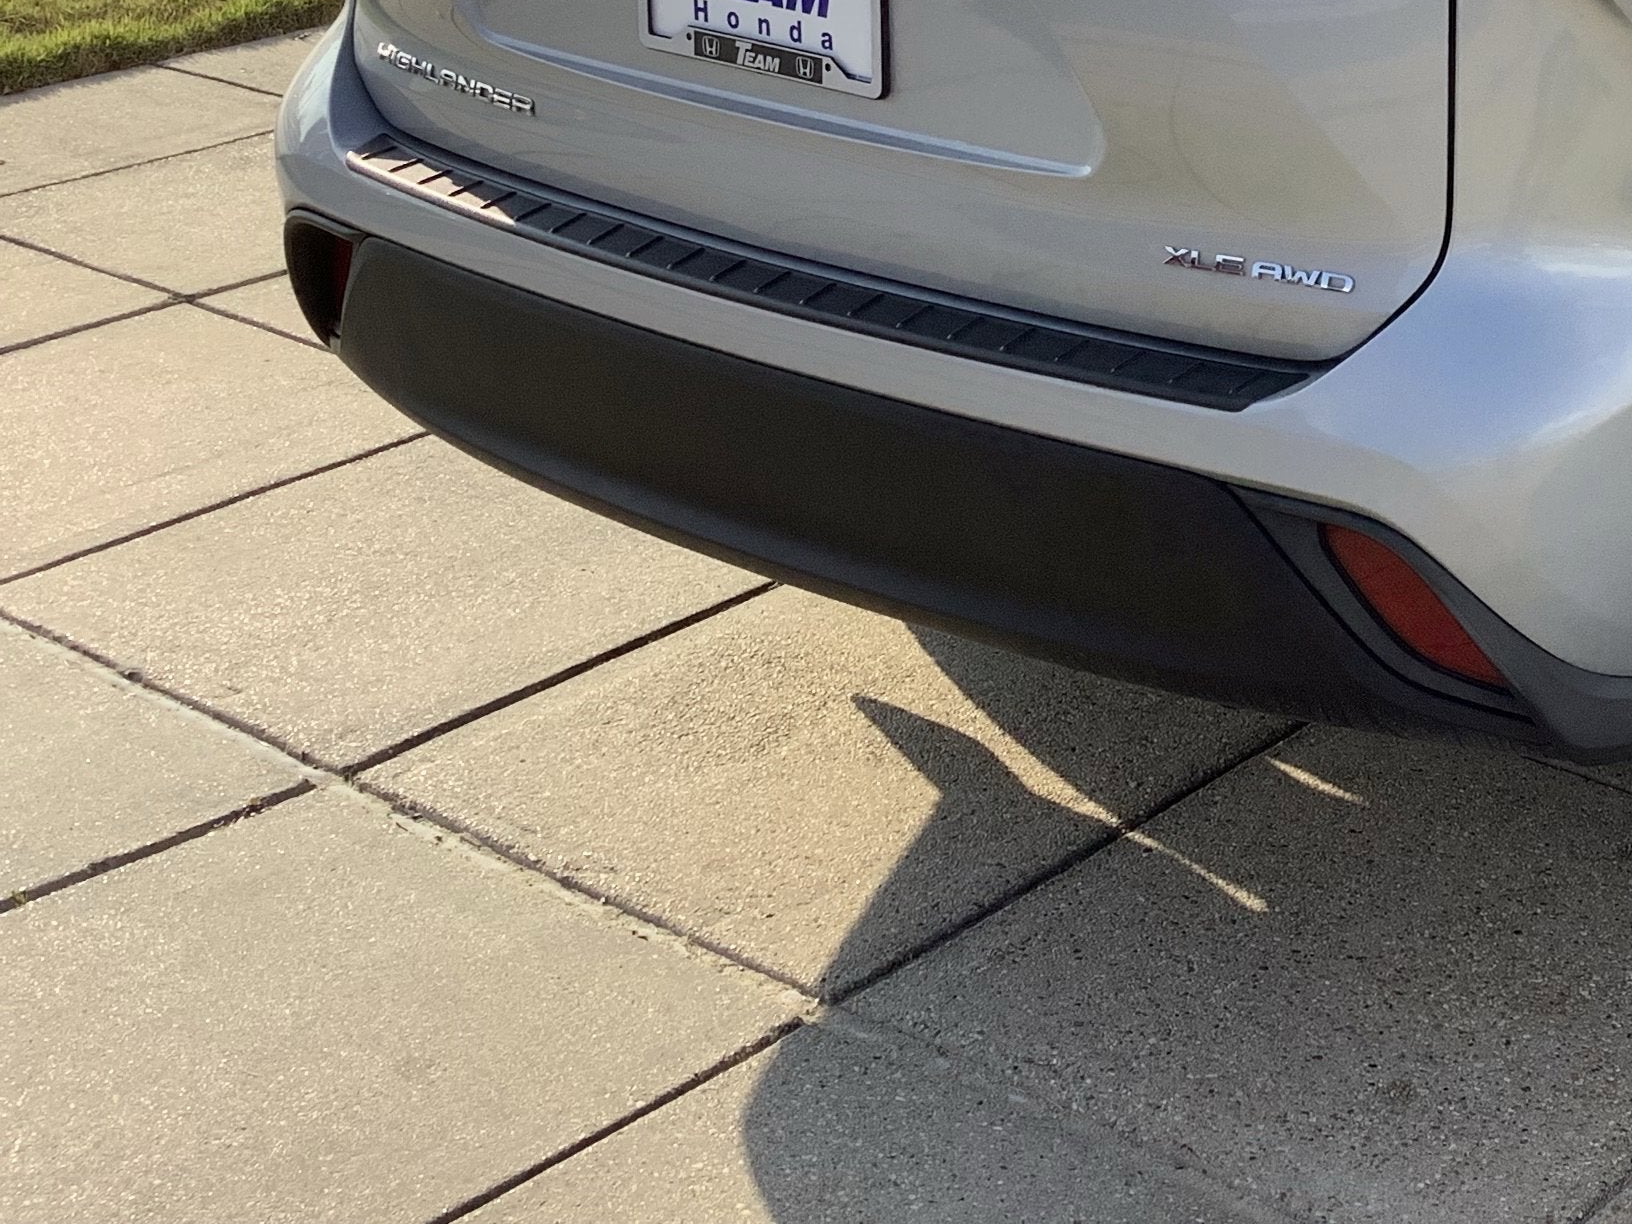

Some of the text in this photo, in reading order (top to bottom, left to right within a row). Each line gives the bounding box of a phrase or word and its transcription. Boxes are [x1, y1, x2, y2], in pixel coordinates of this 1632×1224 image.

[377, 41, 536, 116] HIGHLANDER
[736, 39, 780, 73] TEAM
[1162, 245, 1355, 293] XLE AWD
